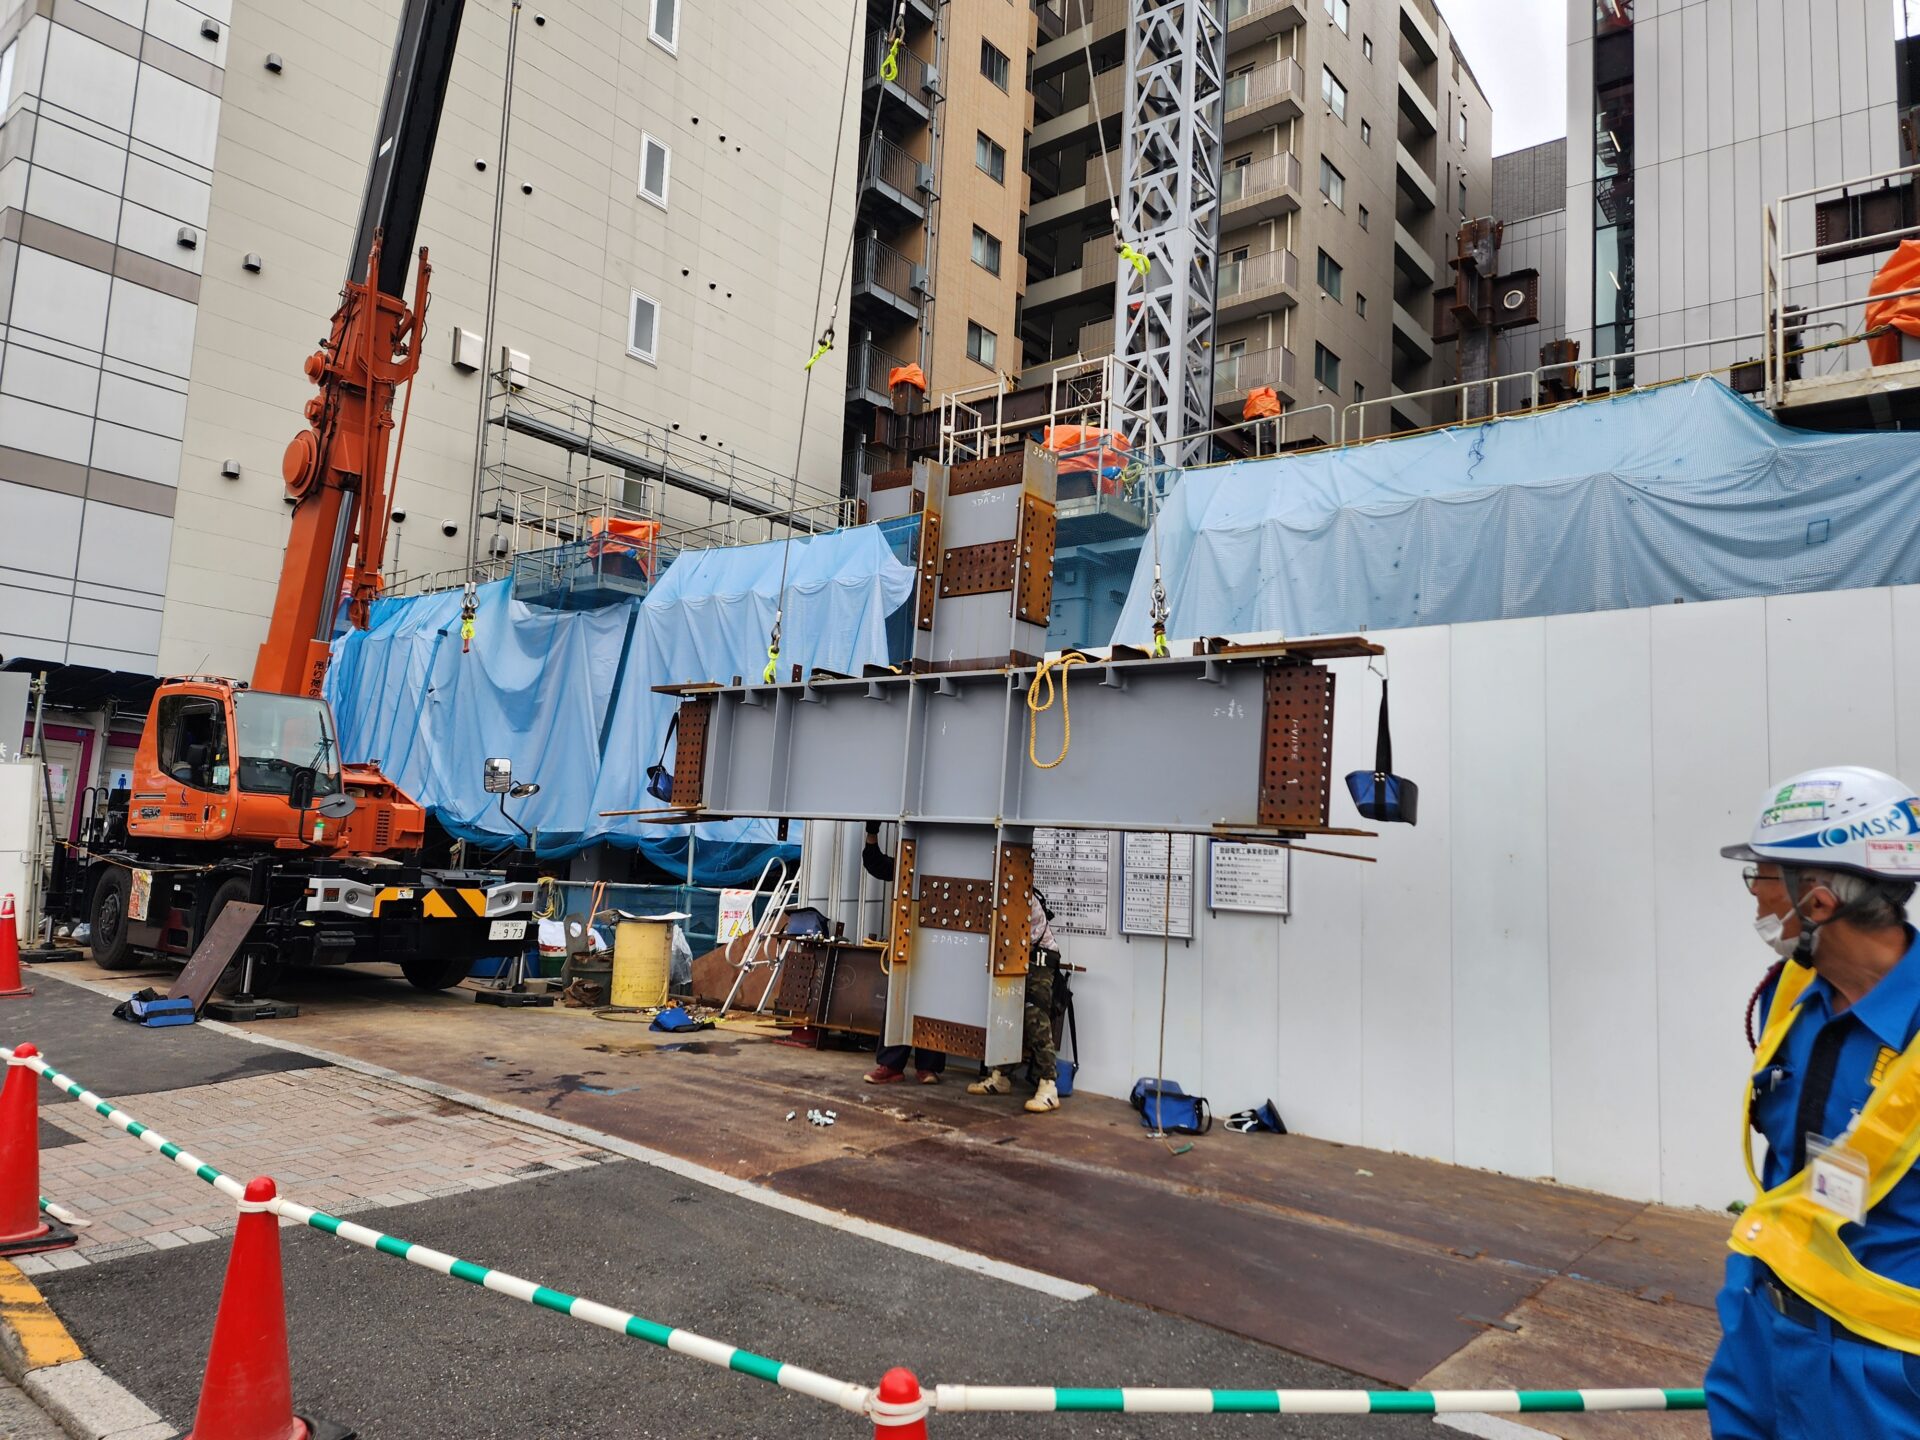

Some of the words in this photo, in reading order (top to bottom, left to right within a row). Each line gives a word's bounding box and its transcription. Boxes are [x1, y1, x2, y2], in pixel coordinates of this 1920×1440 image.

[1133, 873, 1183, 881] 労災保険関係立票
